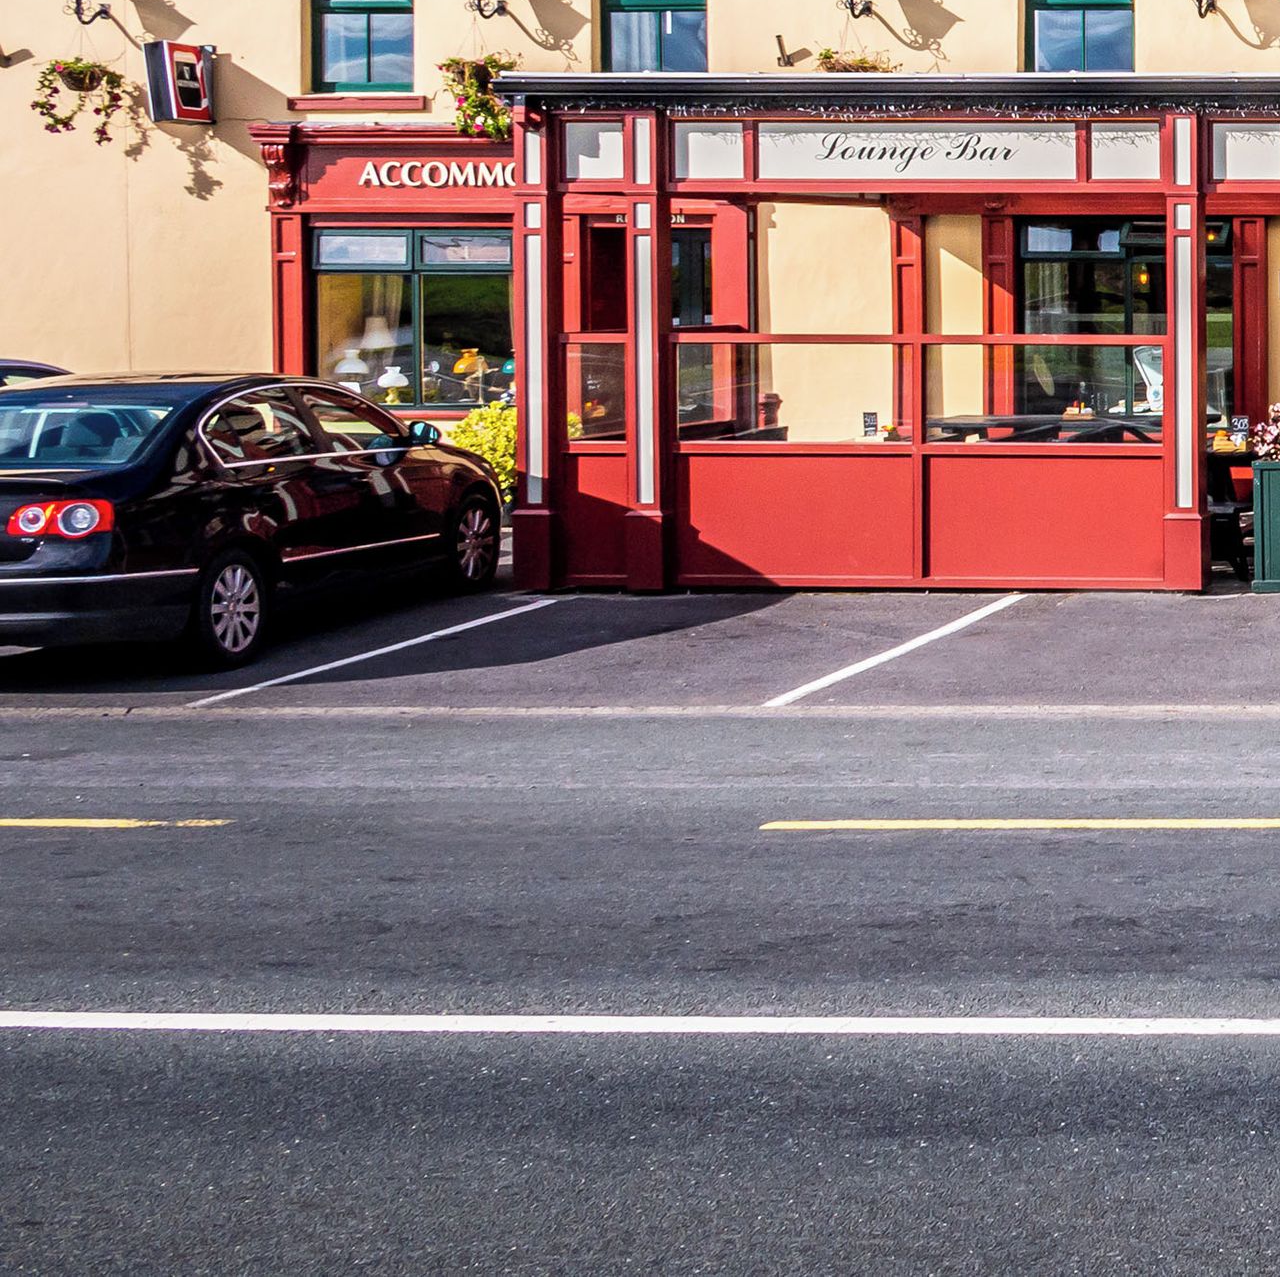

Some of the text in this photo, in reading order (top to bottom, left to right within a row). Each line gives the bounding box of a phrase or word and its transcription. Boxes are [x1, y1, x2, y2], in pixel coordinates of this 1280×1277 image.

[815, 132, 1020, 173] Lounge Bar
[1232, 417, 1249, 431] 303
